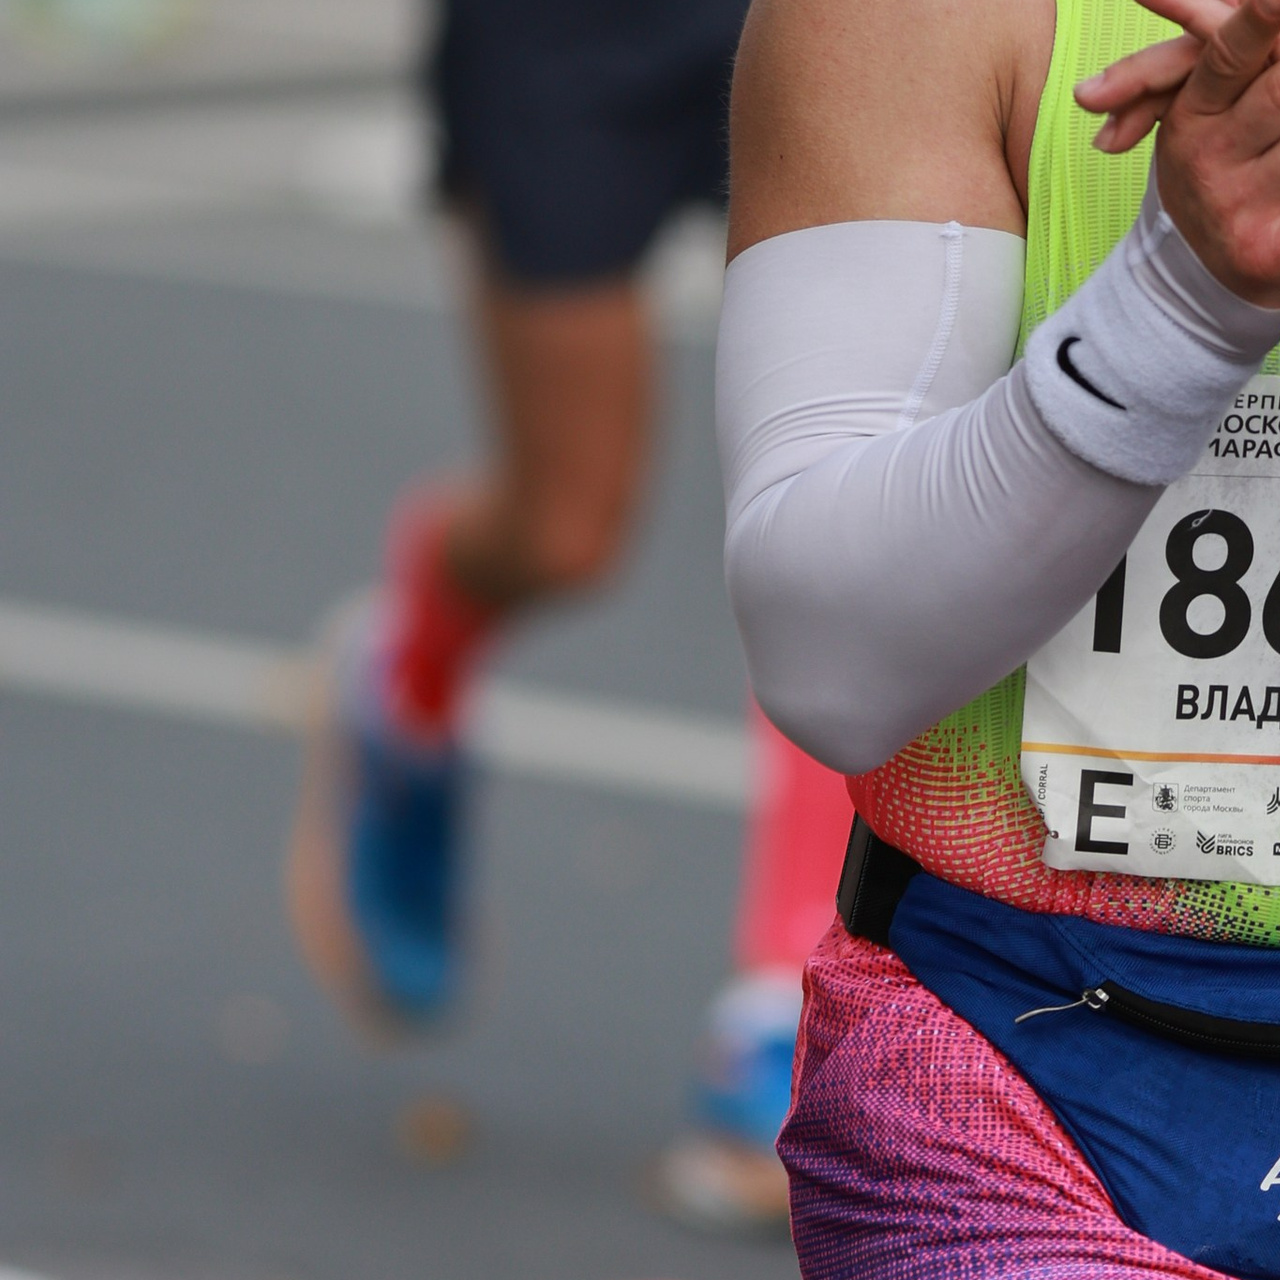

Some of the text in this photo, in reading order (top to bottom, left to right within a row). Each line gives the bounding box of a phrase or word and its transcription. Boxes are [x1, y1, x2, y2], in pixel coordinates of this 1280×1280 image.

[1037, 763, 1048, 800] CORRAL
[1183, 785, 1236, 794] Департамент
[1183, 795, 1211, 803] спорта
[1183, 804, 1244, 813] города Москвы
[1216, 845, 1254, 857] BRICS
